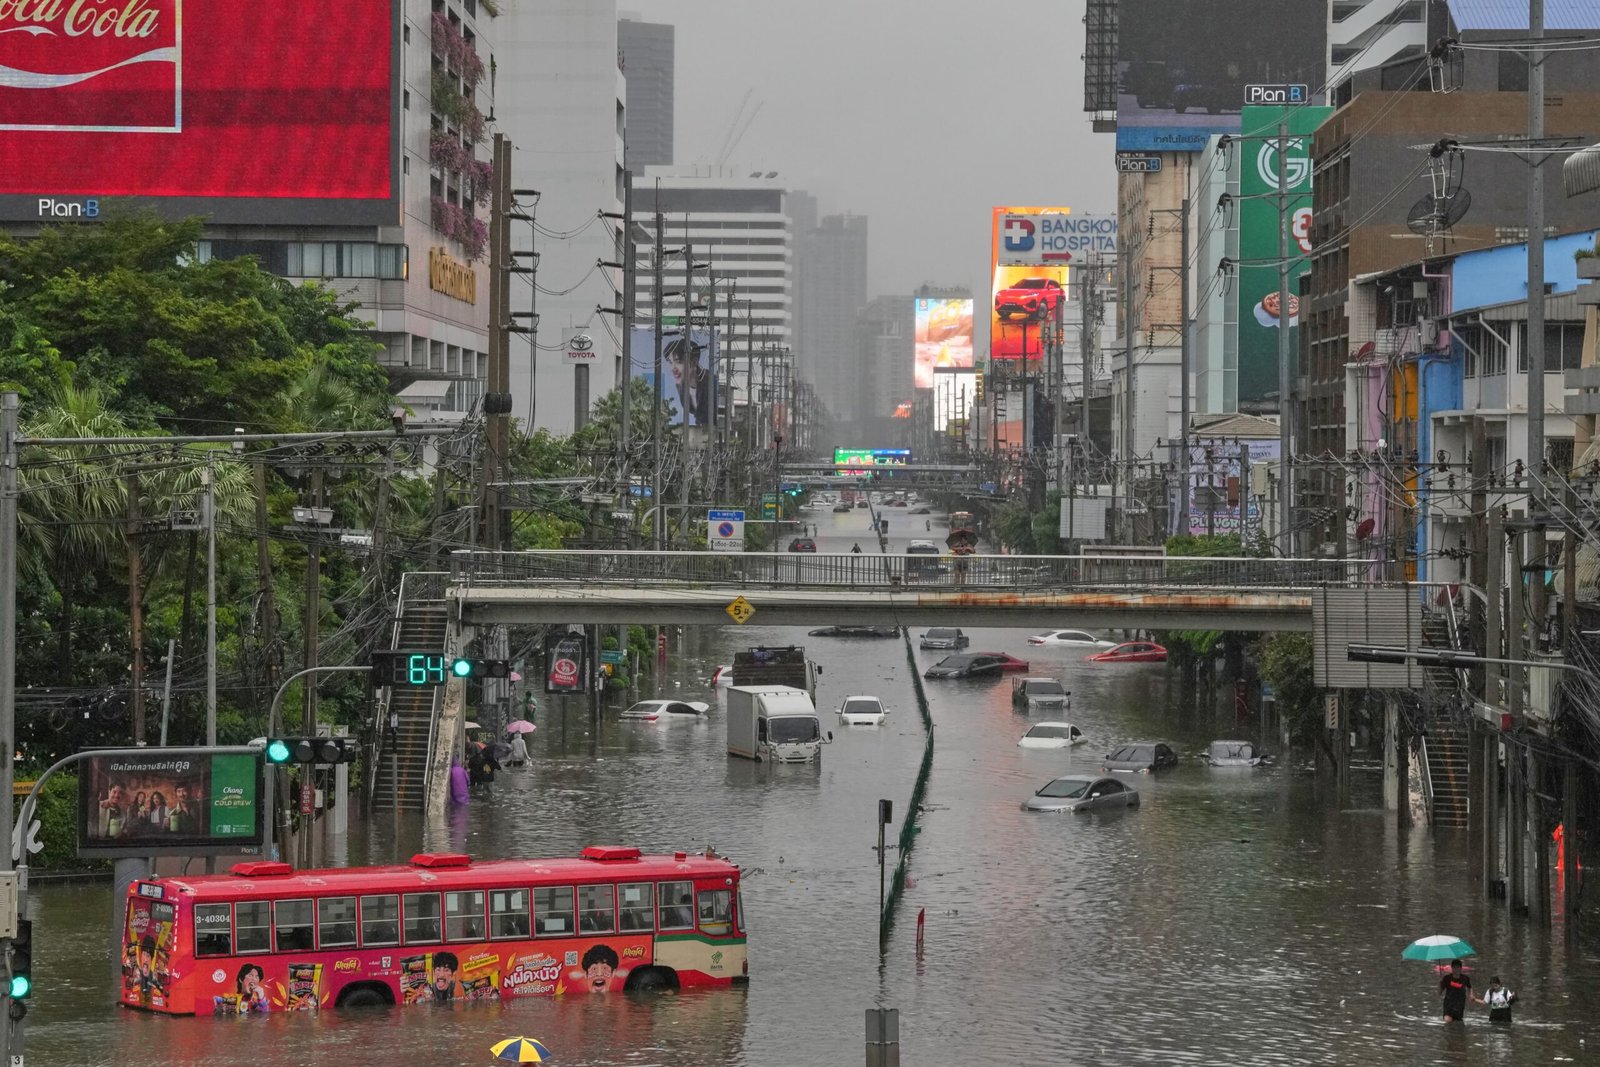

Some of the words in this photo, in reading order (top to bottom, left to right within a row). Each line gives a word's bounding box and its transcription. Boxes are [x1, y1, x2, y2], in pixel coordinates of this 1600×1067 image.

[1251, 87, 1285, 102] Plan
[1290, 87, 1301, 101] B
[1120, 159, 1147, 170] Plan
[1150, 159, 1159, 170] B
[39, 199, 81, 216] Plan
[87, 200, 99, 216] B
[734, 605, 741, 615] 5
[410, 655, 443, 683] 64
[555, 673, 574, 681] SINGHA
[223, 786, 243, 795] Chang
[196, 915, 230, 924] 3-40304
[15, 1055, 20, 1065] 3
